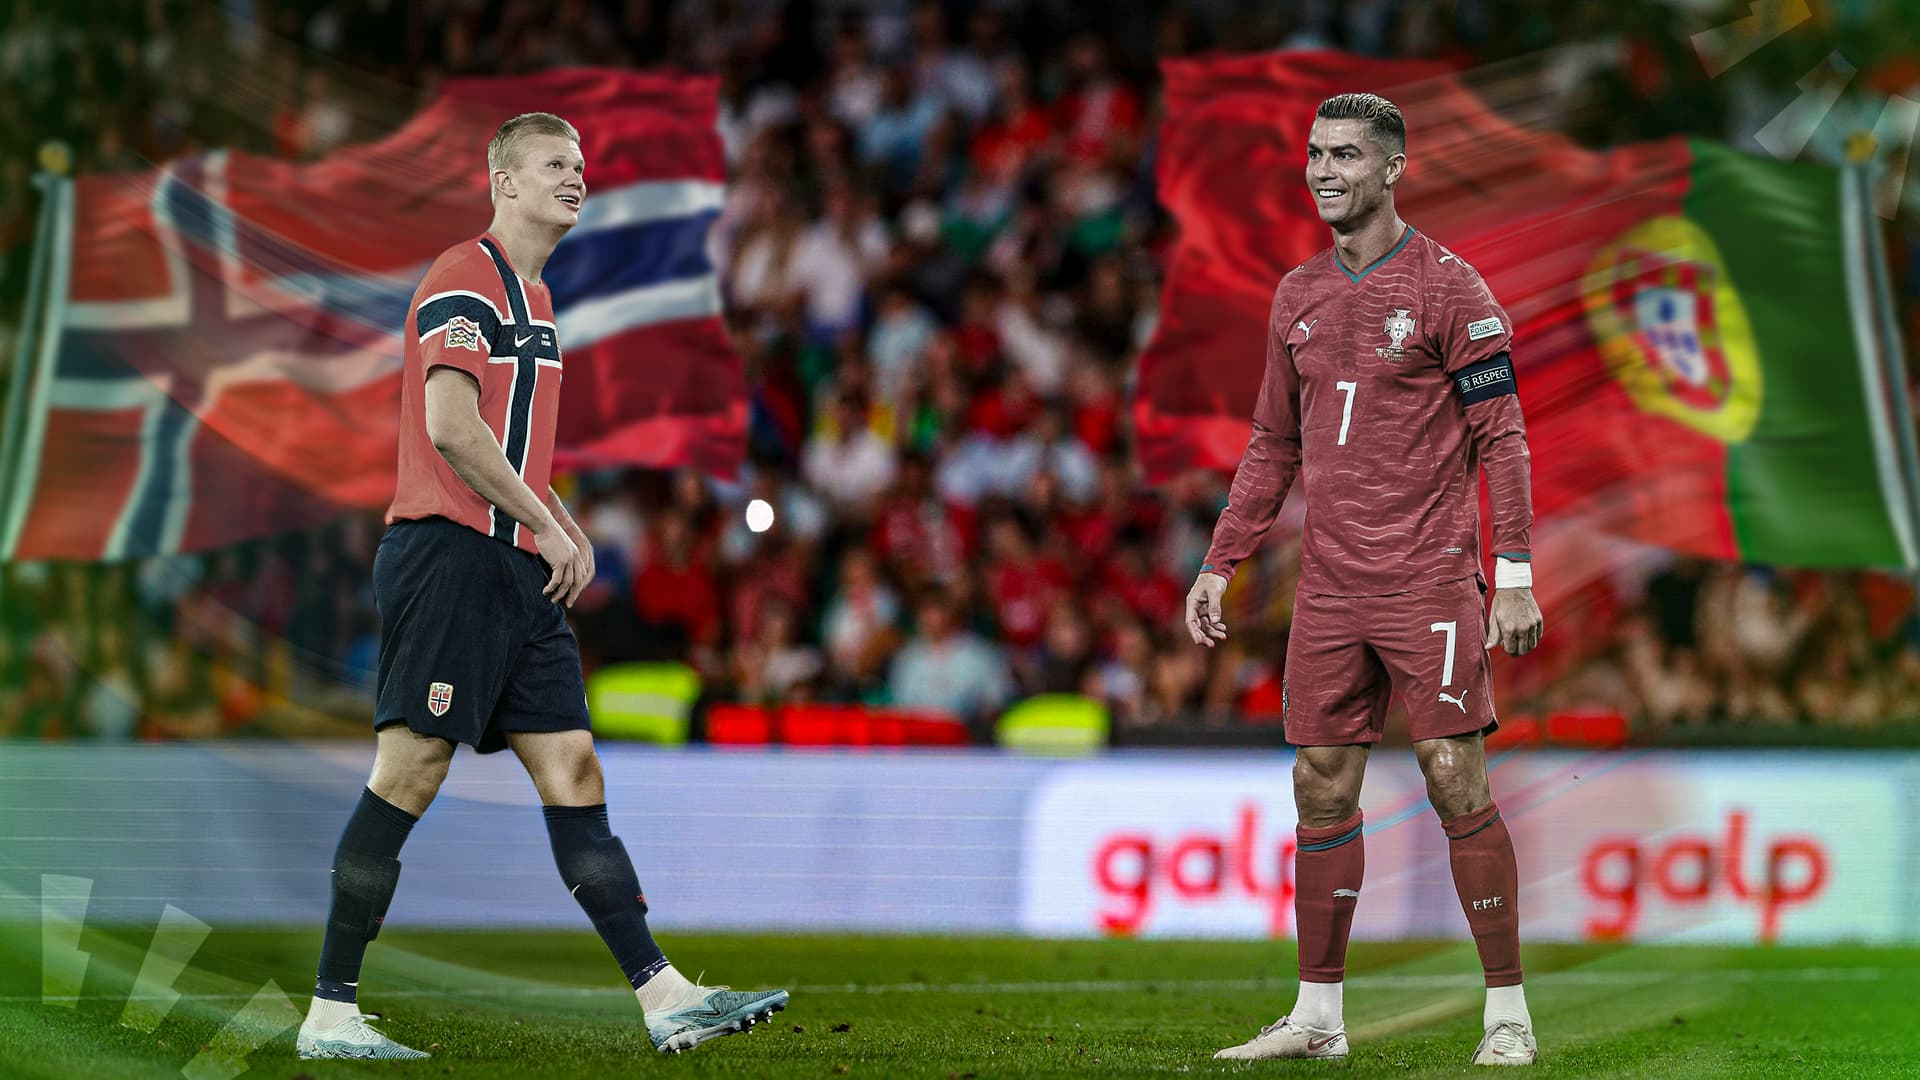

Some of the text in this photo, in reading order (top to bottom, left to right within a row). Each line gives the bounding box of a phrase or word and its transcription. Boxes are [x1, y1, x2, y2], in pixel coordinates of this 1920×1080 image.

[1472, 369, 1509, 386] RESPECT
[1336, 381, 1357, 446] 7
[1430, 621, 1457, 687] 7
[1581, 808, 1830, 942] galp
